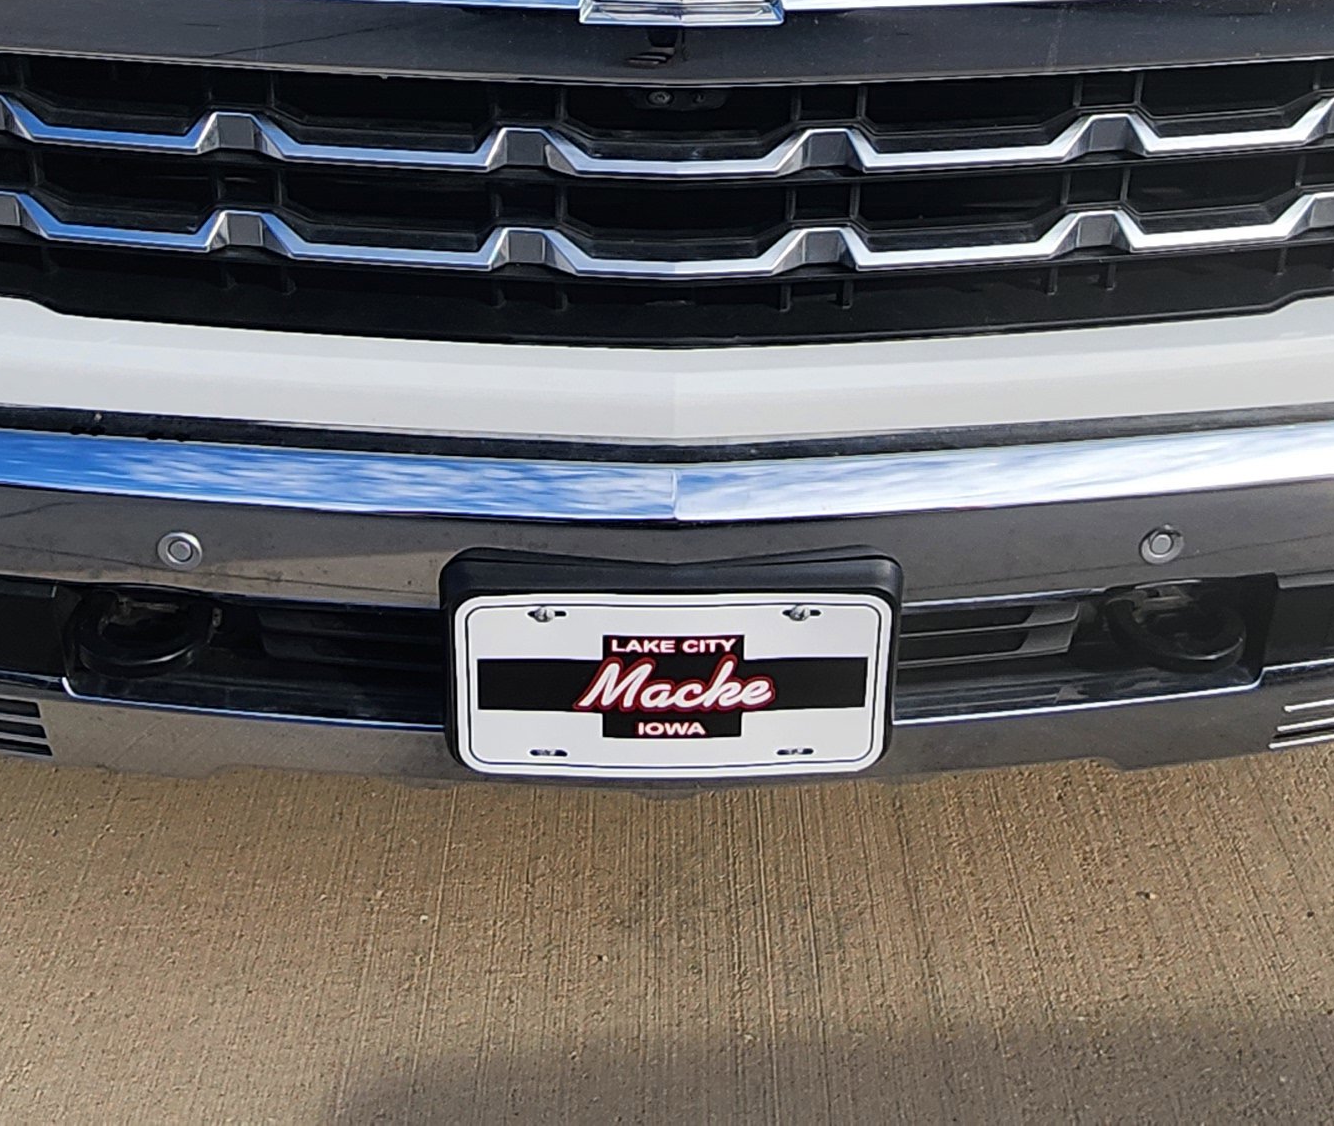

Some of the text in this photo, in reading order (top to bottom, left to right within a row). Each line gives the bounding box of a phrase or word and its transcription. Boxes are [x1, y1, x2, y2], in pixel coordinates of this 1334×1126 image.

[611, 638, 737, 653] LAKE CITY
[575, 657, 774, 710] Macke
[637, 721, 706, 736] IOWA
